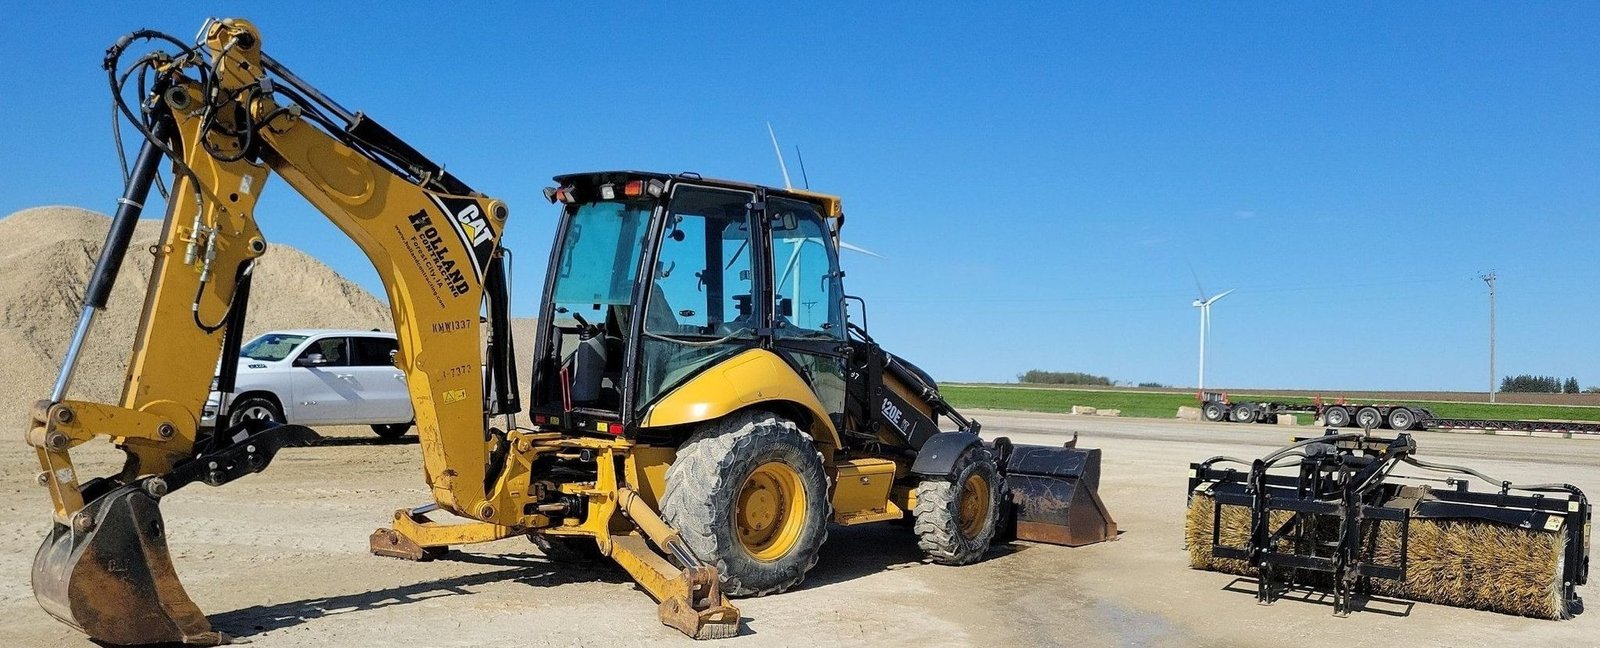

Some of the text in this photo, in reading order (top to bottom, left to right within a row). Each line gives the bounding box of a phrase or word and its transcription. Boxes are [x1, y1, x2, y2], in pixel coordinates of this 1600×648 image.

[408, 208, 469, 294] HOLLAND
[457, 204, 493, 247] CAT
[395, 225, 446, 309] www.hollandcontracting.com
[411, 236, 443, 288] Forest City, IA
[419, 233, 459, 298] CONTRACTING
